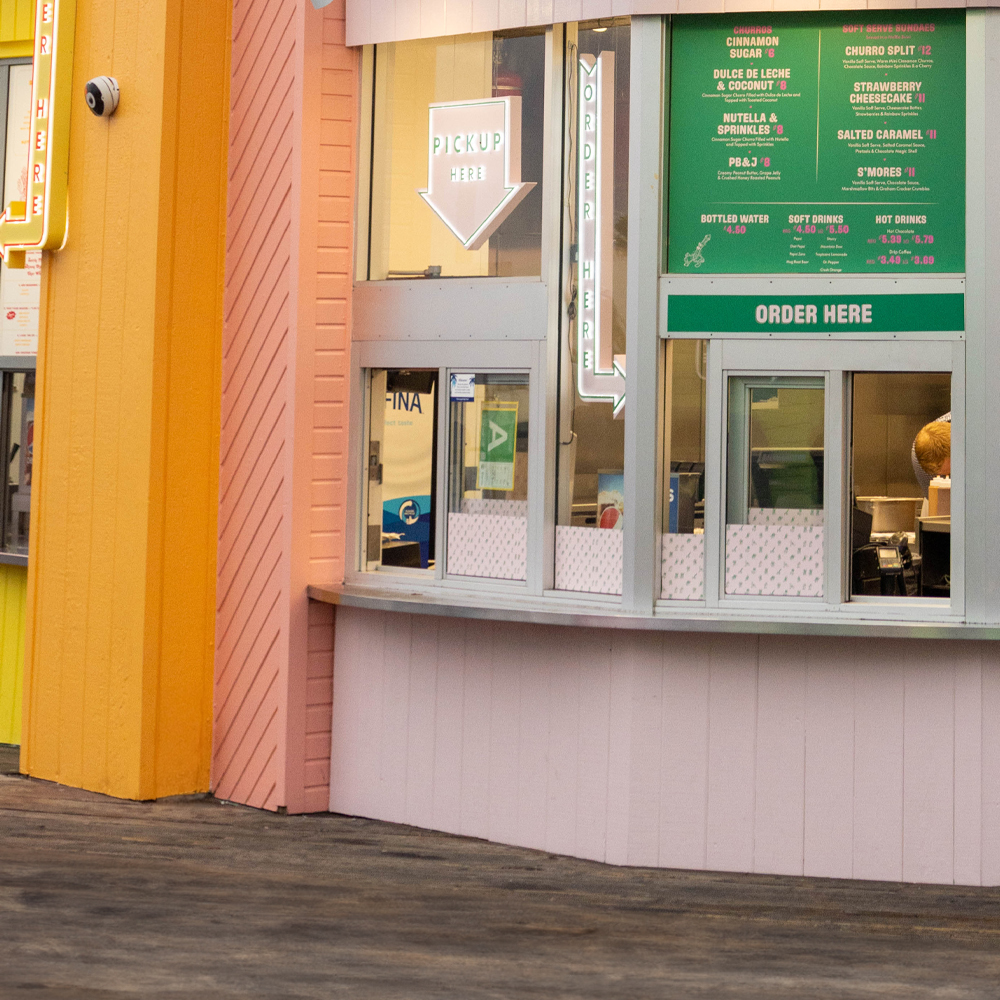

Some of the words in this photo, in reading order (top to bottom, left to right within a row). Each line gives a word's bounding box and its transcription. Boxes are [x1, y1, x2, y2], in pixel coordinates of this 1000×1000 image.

[733, 26, 773, 35] CHURROS
[842, 24, 864, 34] SOFT
[865, 24, 893, 33] SERVE
[895, 24, 935, 32] SUNDAES
[726, 36, 779, 47] CINNAMON
[729, 48, 762, 59] SUGAR
[845, 45, 885, 56] CHURRO
[887, 45, 915, 55] SPLIT
[713, 69, 744, 79] DULCE
[746, 69, 758, 79] DE
[761, 68, 791, 79] LECHE
[717, 81, 726, 91] &
[728, 80, 774, 91] COCONUT
[853, 81, 922, 92] STRAWBERRY
[849, 93, 912, 104] CHEESECAKE
[723, 113, 766, 123] NUTELLA
[769, 112, 778, 123] &
[717, 124, 770, 135] SPRINKLES
[837, 129, 874, 140] SALTED
[876, 129, 923, 140] CARAMEL
[433, 132, 502, 154] PICKUP
[32, 99, 46, 215] HERE
[582, 84, 594, 220] ORDER
[728, 157, 757, 167] PB&J
[450, 166, 483, 181] HERE
[857, 167, 902, 177] S'MORES
[701, 214, 738, 223] BOTTLED
[739, 214, 769, 224] WATER
[788, 214, 810, 224] SOFT
[812, 214, 843, 224] DRINKS
[875, 215, 893, 224] HOT
[895, 215, 927, 224] DRINKS
[582, 261, 593, 369] HERE
[755, 304, 817, 324] ORDER
[823, 304, 872, 324] HERE
